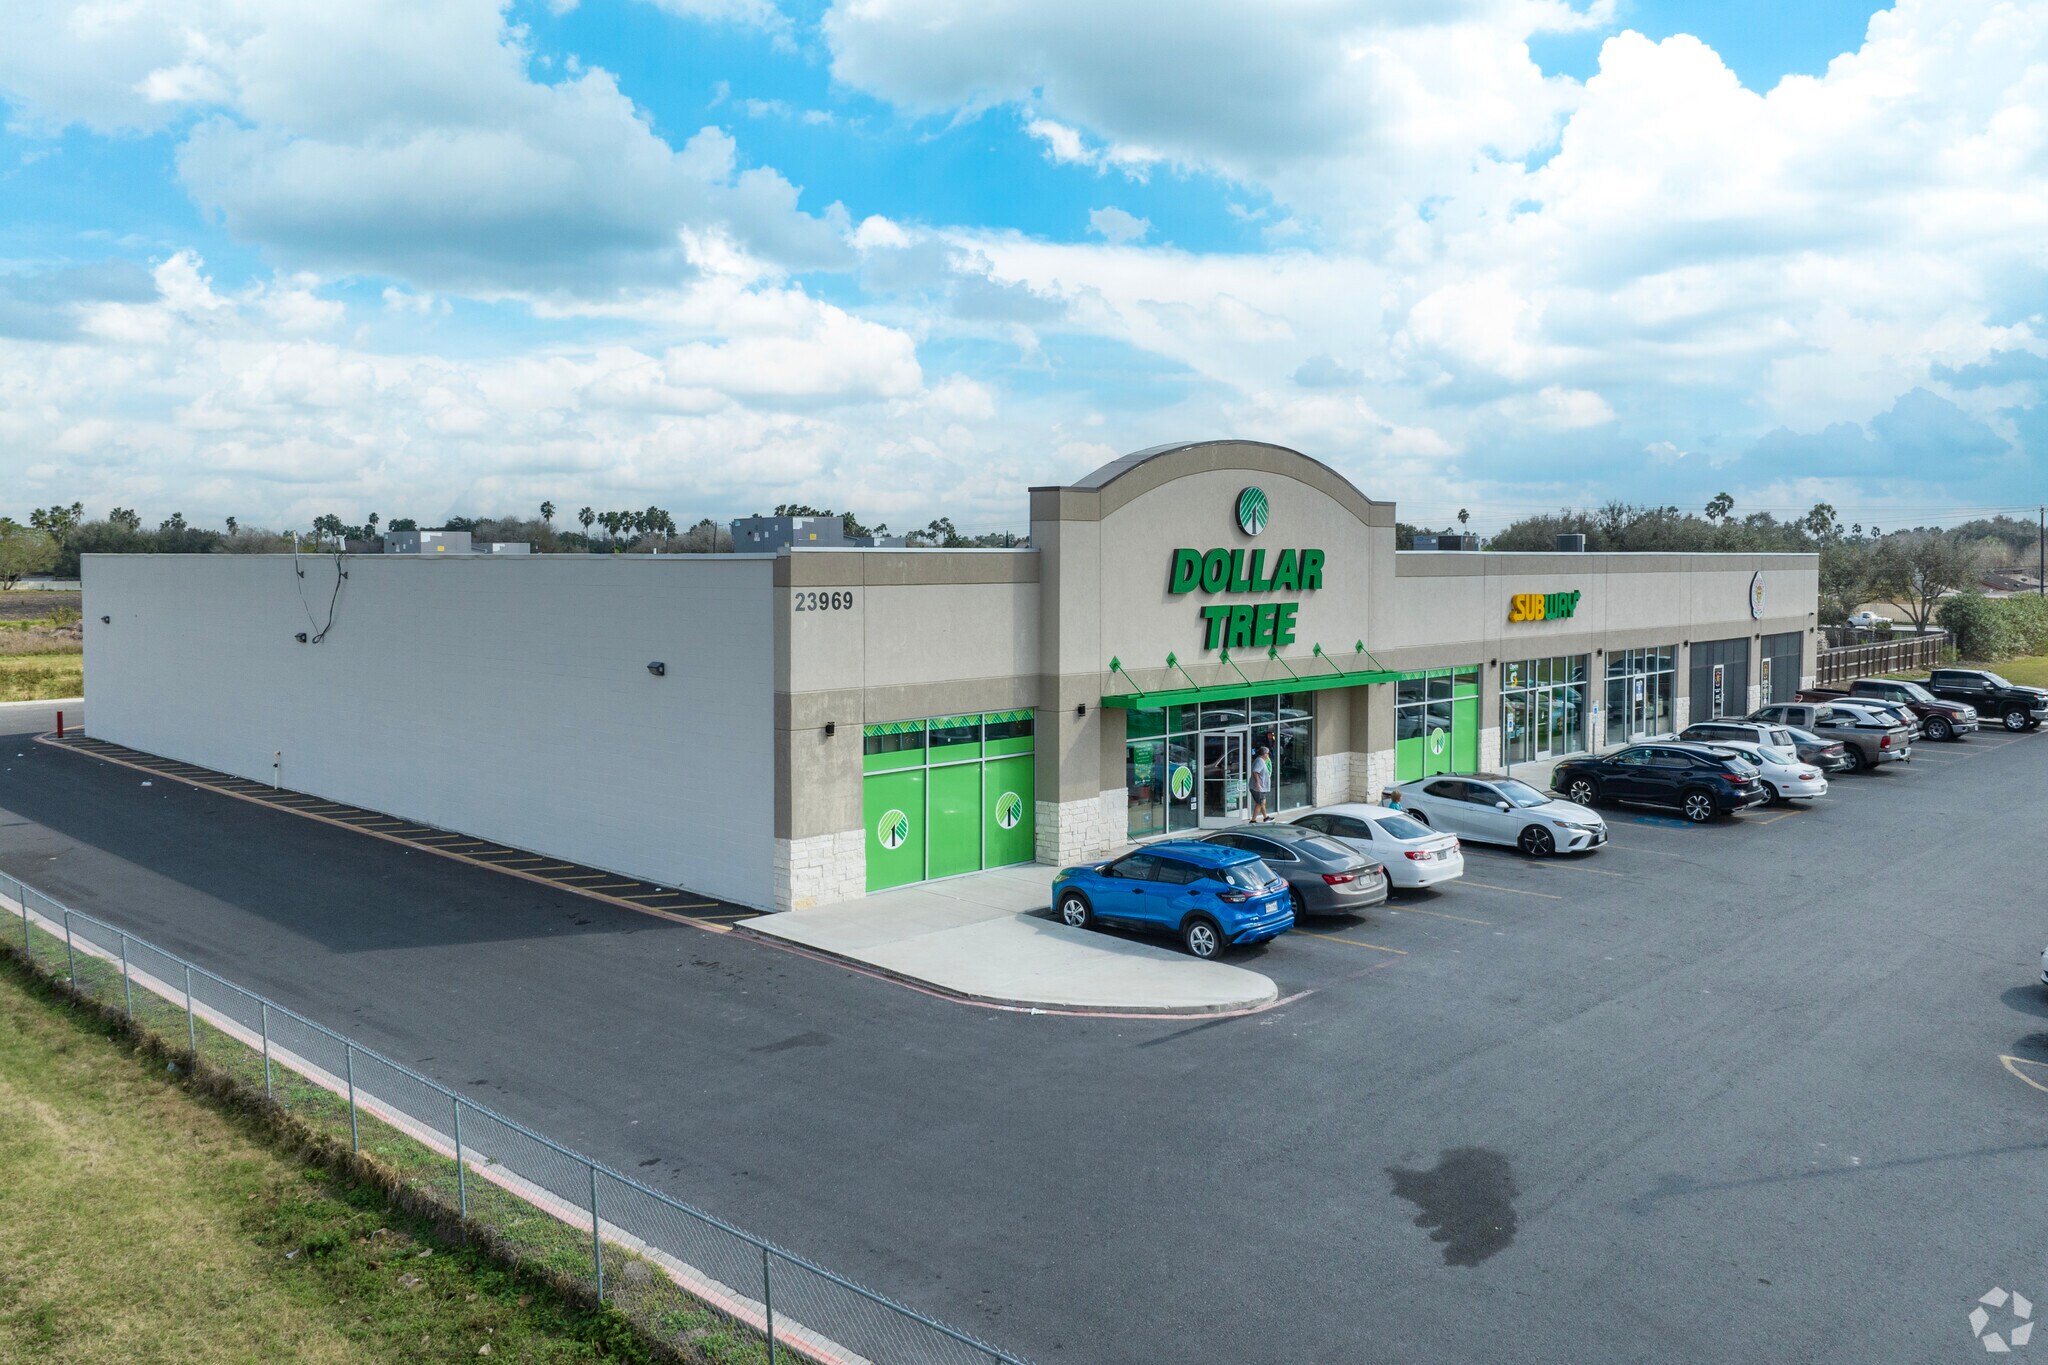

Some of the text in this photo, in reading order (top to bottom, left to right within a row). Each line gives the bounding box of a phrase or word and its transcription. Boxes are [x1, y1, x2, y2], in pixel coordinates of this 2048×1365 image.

[1168, 547, 1325, 594] DOLLAR
[794, 591, 854, 612] 23969
[1508, 590, 1581, 623] SUBWAY
[1201, 602, 1299, 650] TREE
